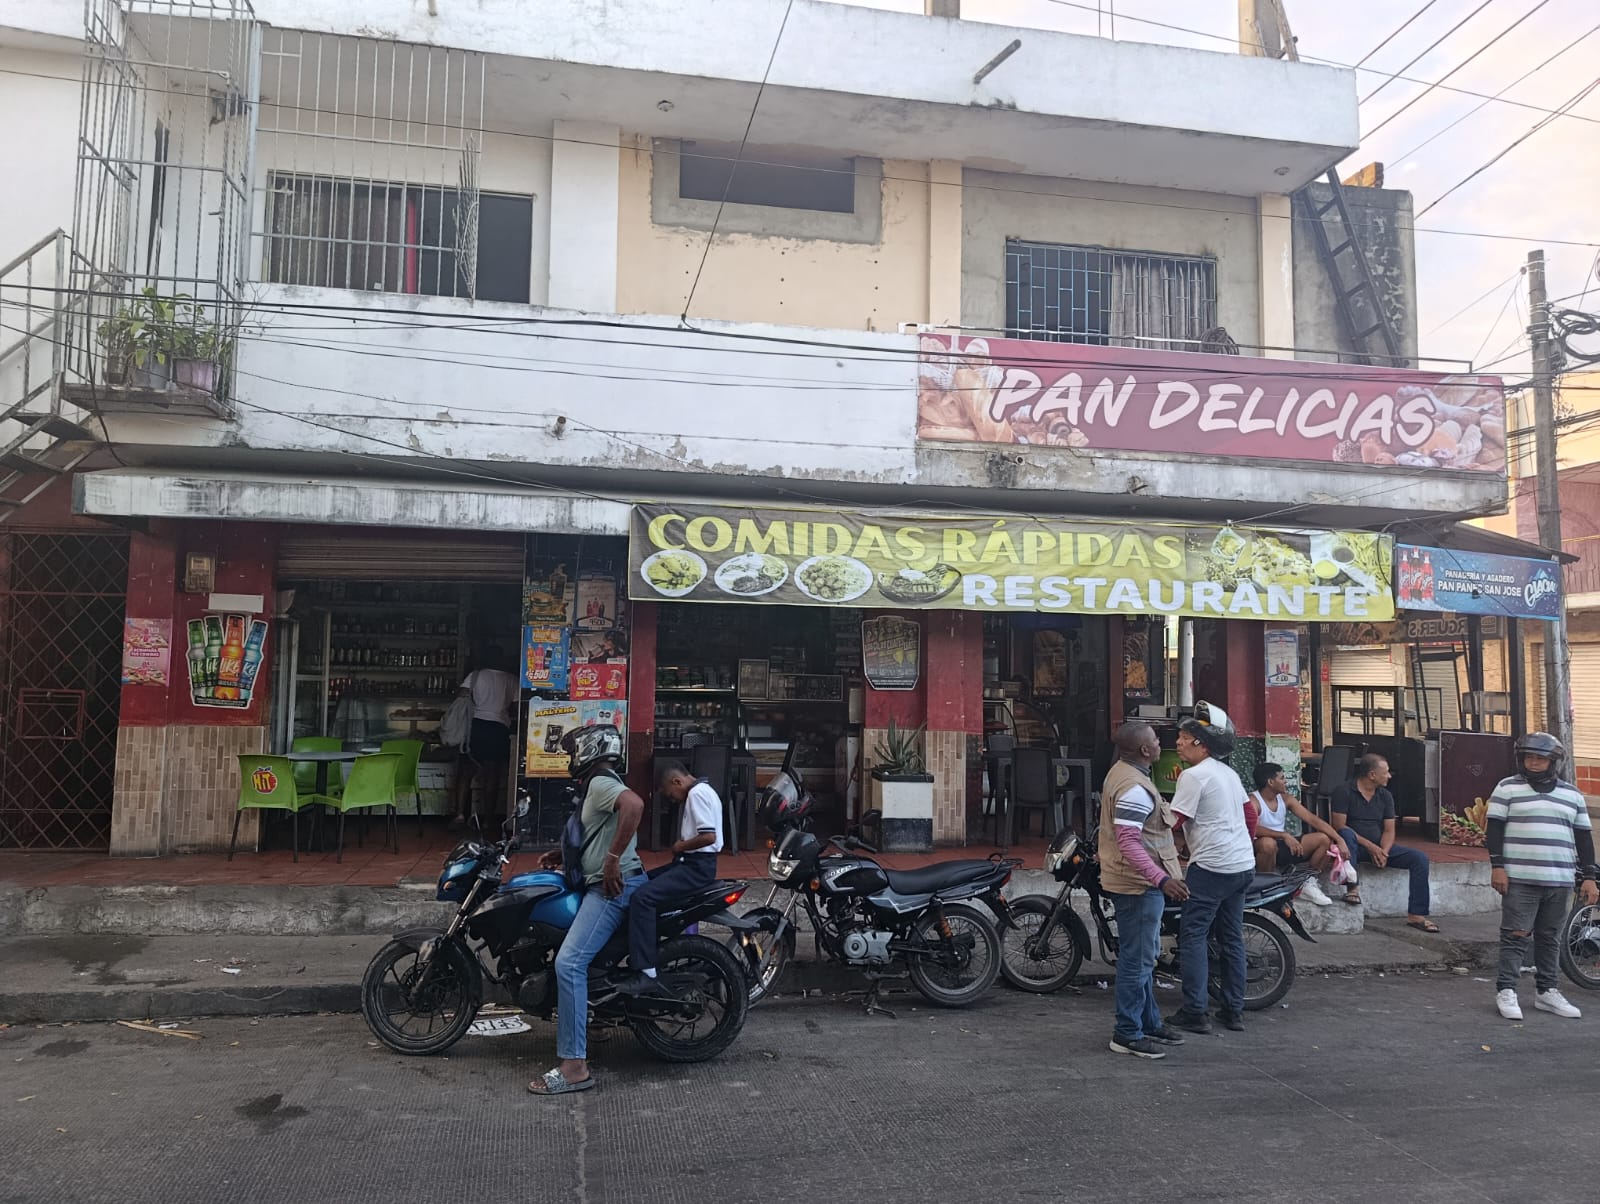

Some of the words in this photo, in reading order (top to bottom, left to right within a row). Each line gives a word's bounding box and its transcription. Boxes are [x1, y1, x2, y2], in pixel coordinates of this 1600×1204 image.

[992, 367, 1137, 427] PAN
[1148, 378, 1437, 448] DELICIAS
[647, 513, 927, 561] COMIDAS
[942, 518, 1184, 570] RÁPIDAS
[961, 572, 1370, 617] RESTAURANTE
[1438, 580, 1455, 592] PAN
[1484, 584, 1501, 596] SAN
[1502, 585, 1522, 598] JOSE
[1481, 573, 1486, 582] Y
